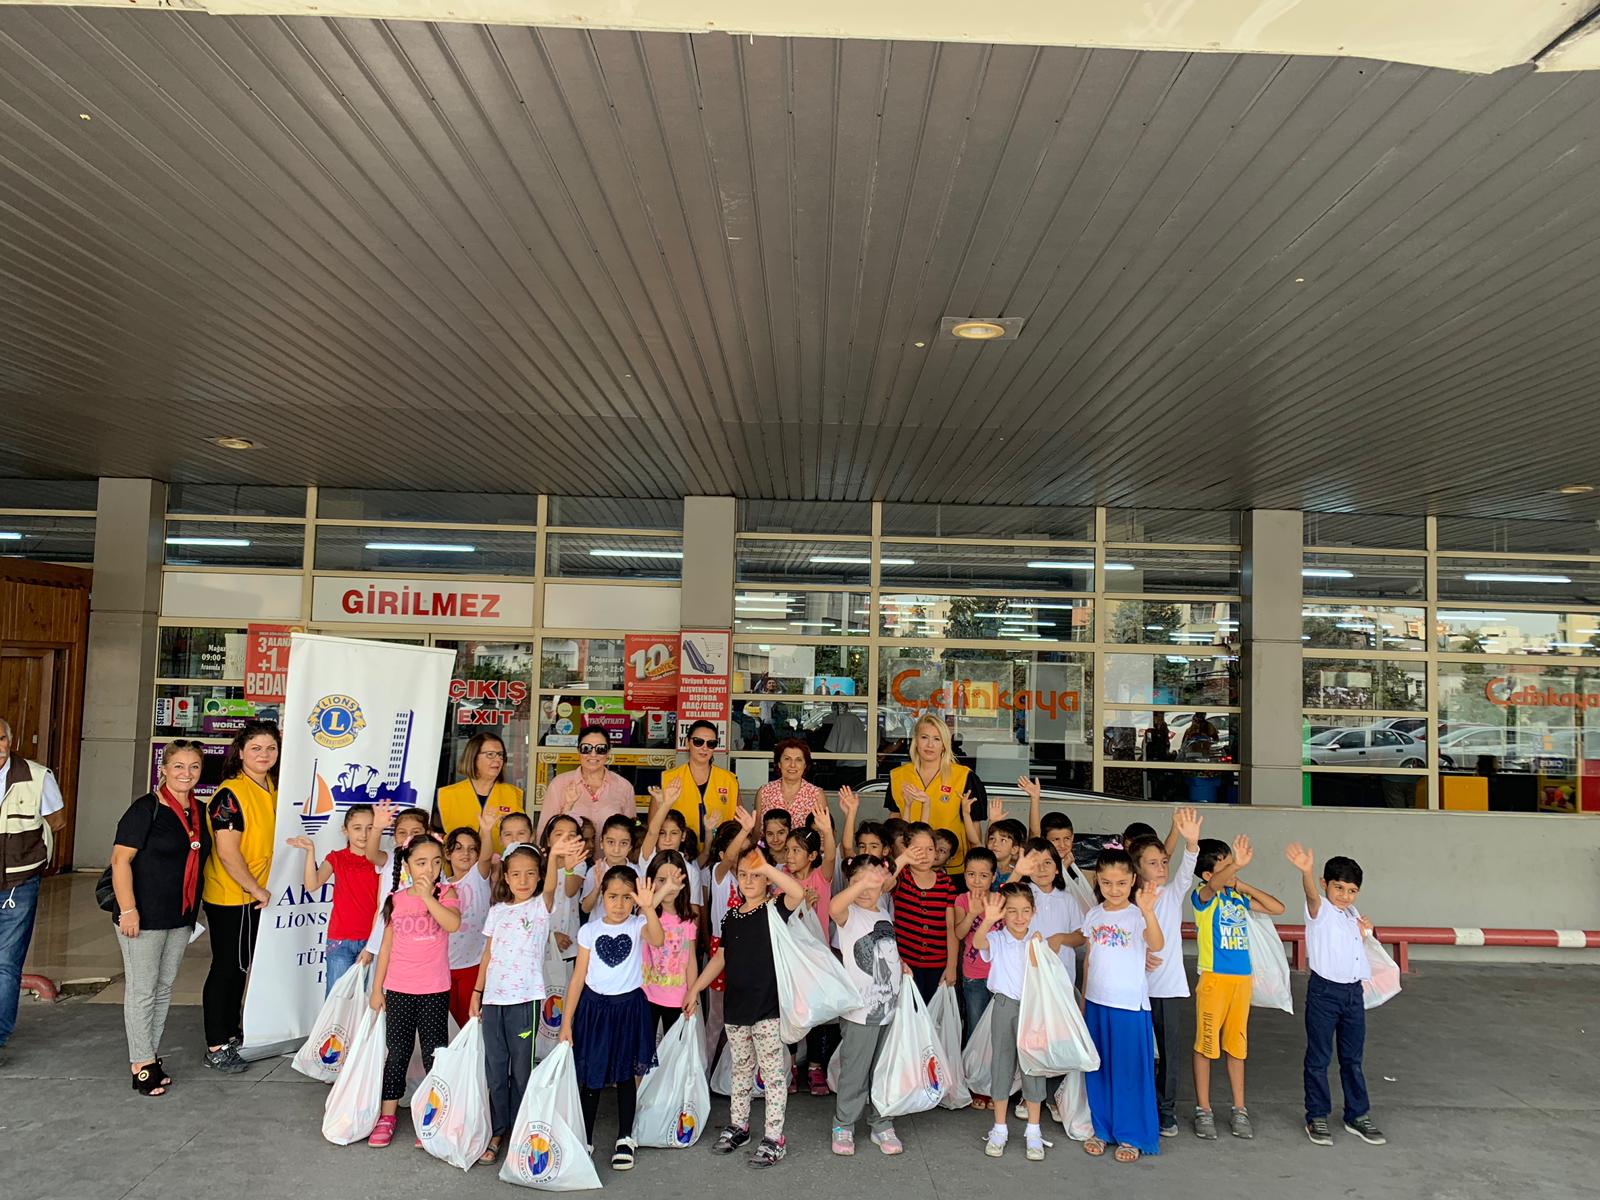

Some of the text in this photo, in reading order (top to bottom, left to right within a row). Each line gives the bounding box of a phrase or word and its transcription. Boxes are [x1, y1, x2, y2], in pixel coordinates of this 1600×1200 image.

[342, 584, 500, 617] GİRİLMEZ
[258, 637, 267, 653] 3
[201, 653, 221, 661] 09:00
[630, 643, 670, 680] 10
[449, 679, 527, 704] ÇIKIŞ
[321, 696, 356, 710] LIONS
[457, 709, 514, 726] EXIT
[275, 911, 327, 929] LİONS
